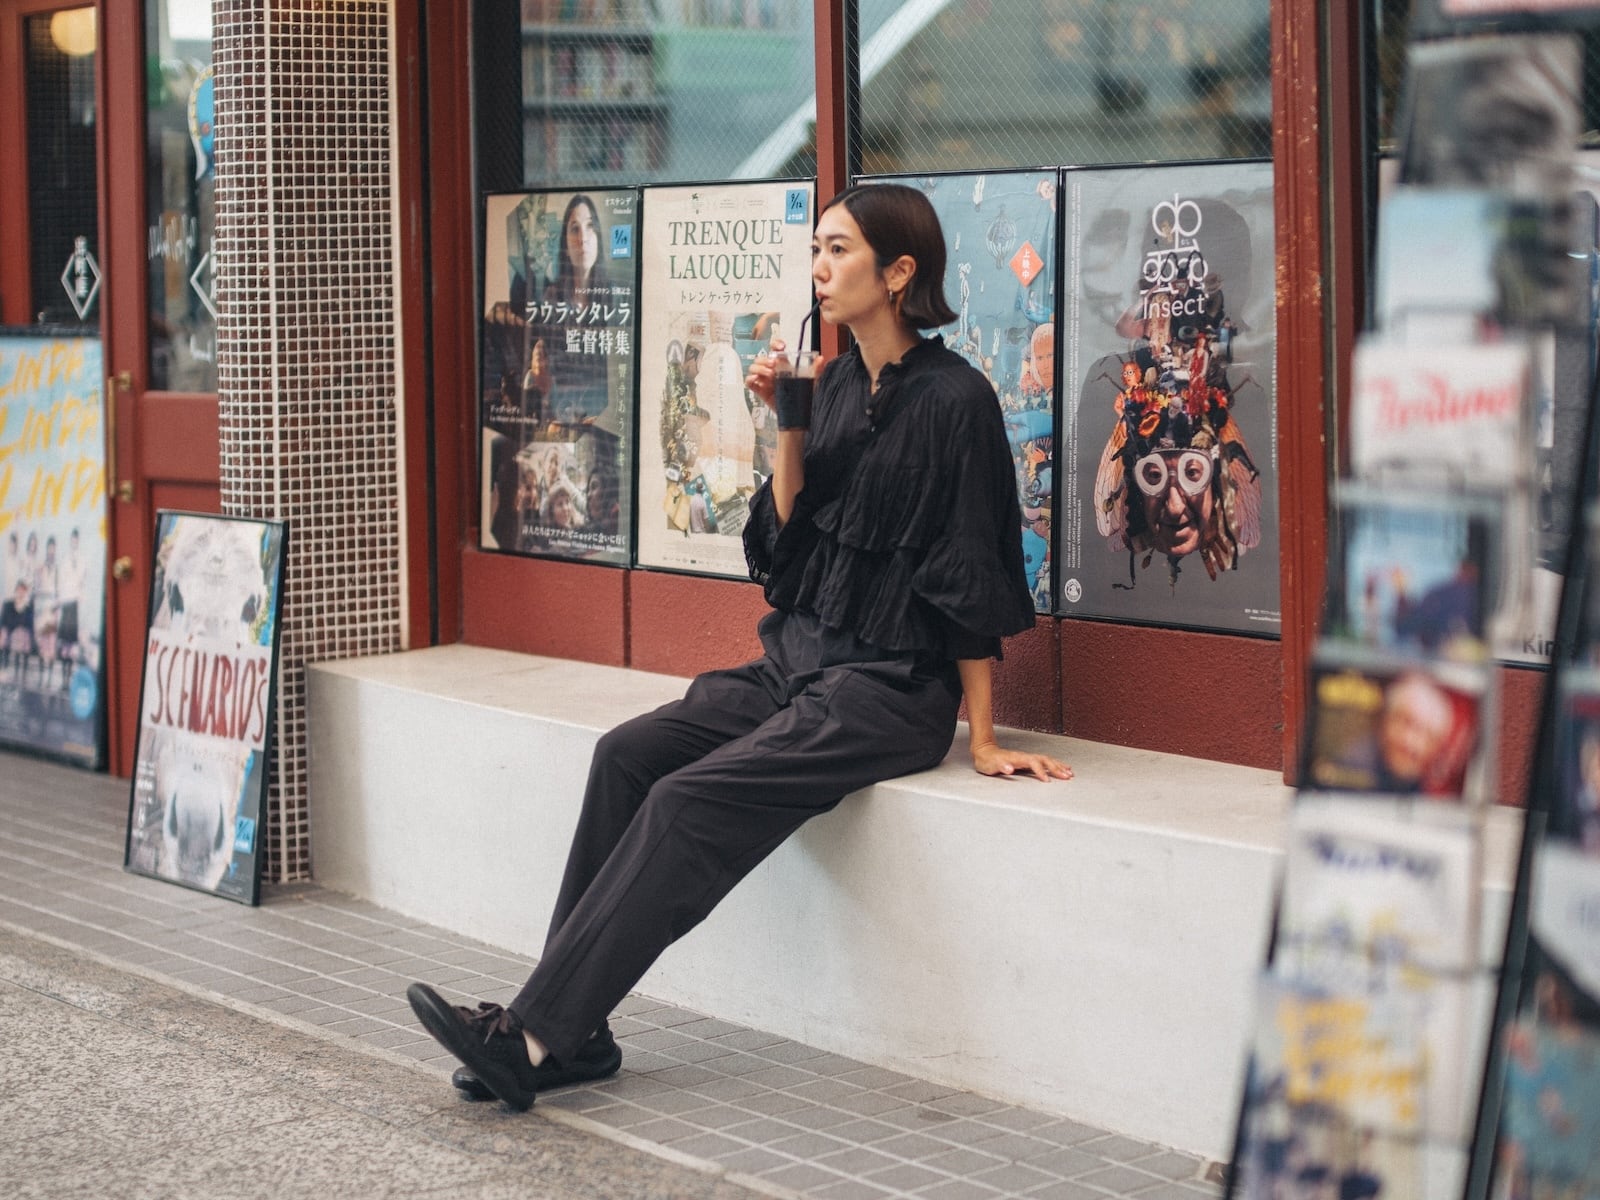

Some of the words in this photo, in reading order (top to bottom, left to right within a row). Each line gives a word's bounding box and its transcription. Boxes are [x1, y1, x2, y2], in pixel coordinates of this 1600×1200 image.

[668, 219, 784, 251] TRENQUE
[668, 254, 784, 286] LAUQUEN
[524, 301, 632, 325] ラウラ・シタレラ
[564, 329, 631, 356] 監督特集
